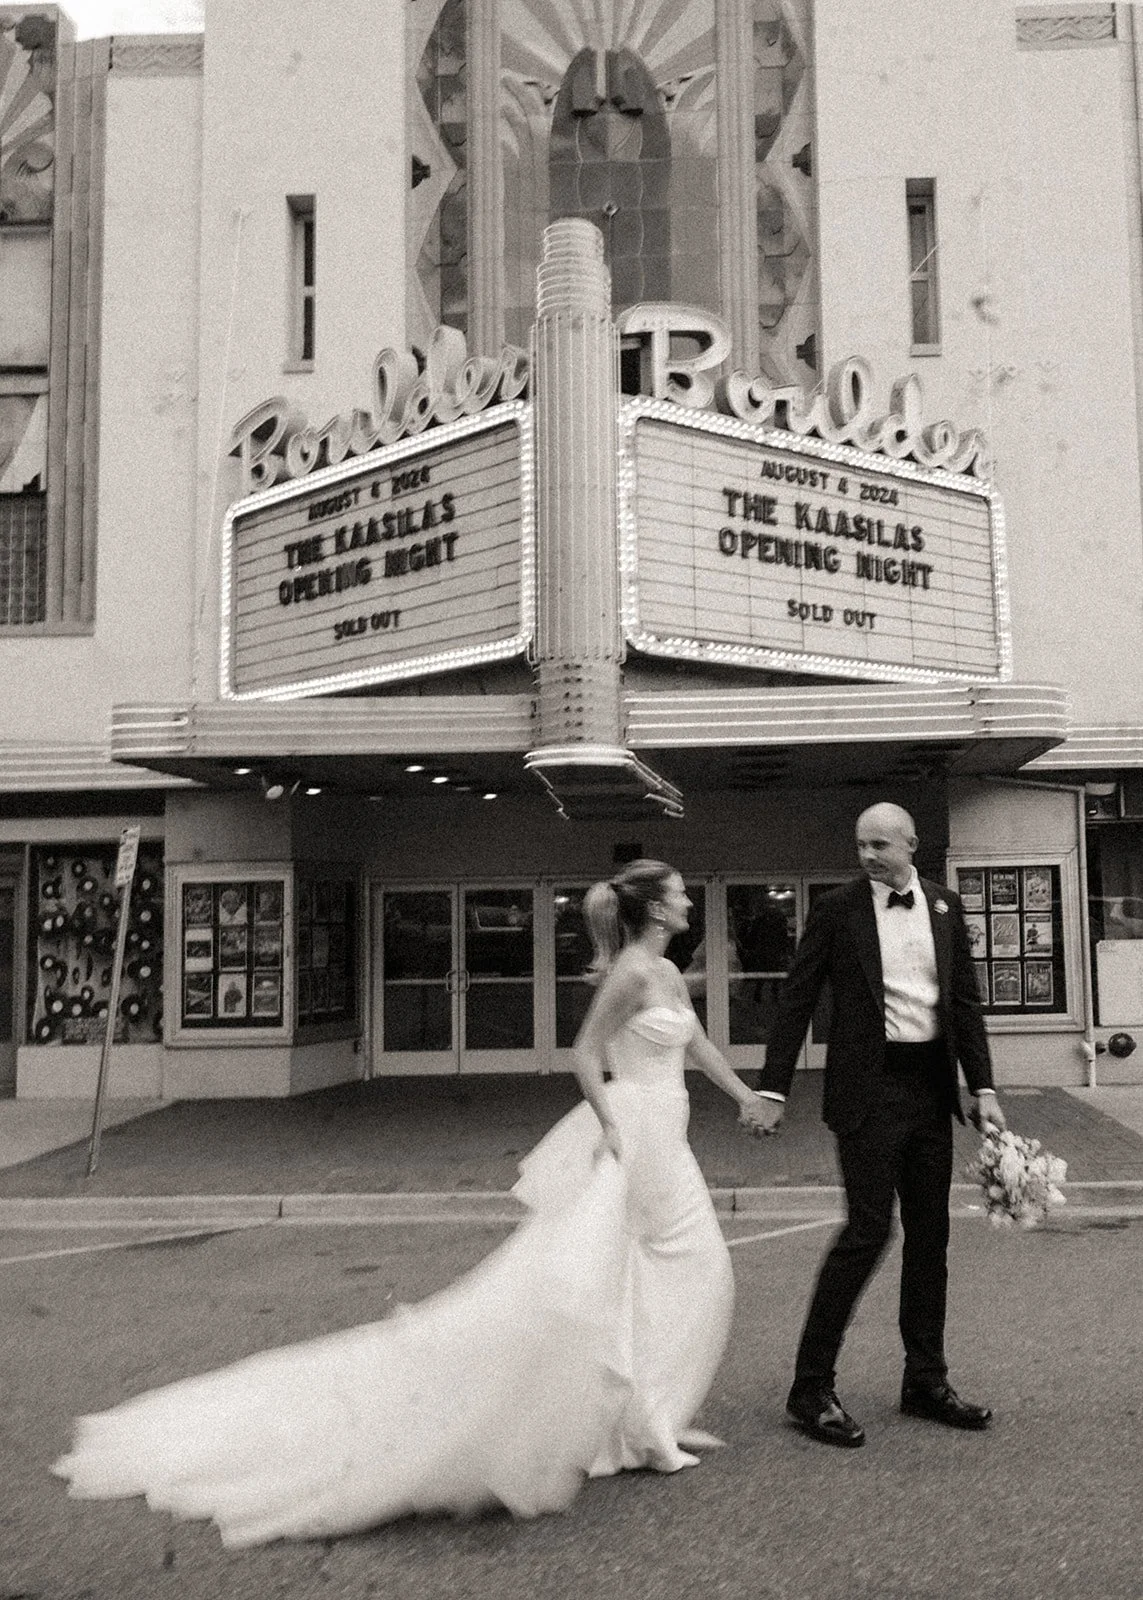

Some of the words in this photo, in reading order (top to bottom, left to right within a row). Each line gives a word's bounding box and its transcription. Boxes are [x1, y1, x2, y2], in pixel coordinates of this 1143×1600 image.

[228, 324, 530, 493] Boulder
[617, 302, 991, 480] Boulder
[308, 487, 361, 521] AUGUST
[761, 460, 830, 489] AUGUST
[838, 477, 849, 494] 4
[860, 483, 899, 506] 2024
[284, 534, 325, 569] THE
[335, 492, 456, 554] KAASILAS
[722, 487, 778, 526] THE
[795, 501, 925, 552] KAASILAS
[279, 556, 372, 606] OPENING
[384, 531, 459, 578] NIGHT
[718, 527, 841, 574] OPENING
[856, 551, 933, 590] NIGHT
[334, 616, 367, 640] SOLD
[371, 609, 402, 630] OUT
[787, 599, 834, 623] SOLD
[843, 608, 877, 630] OUT
